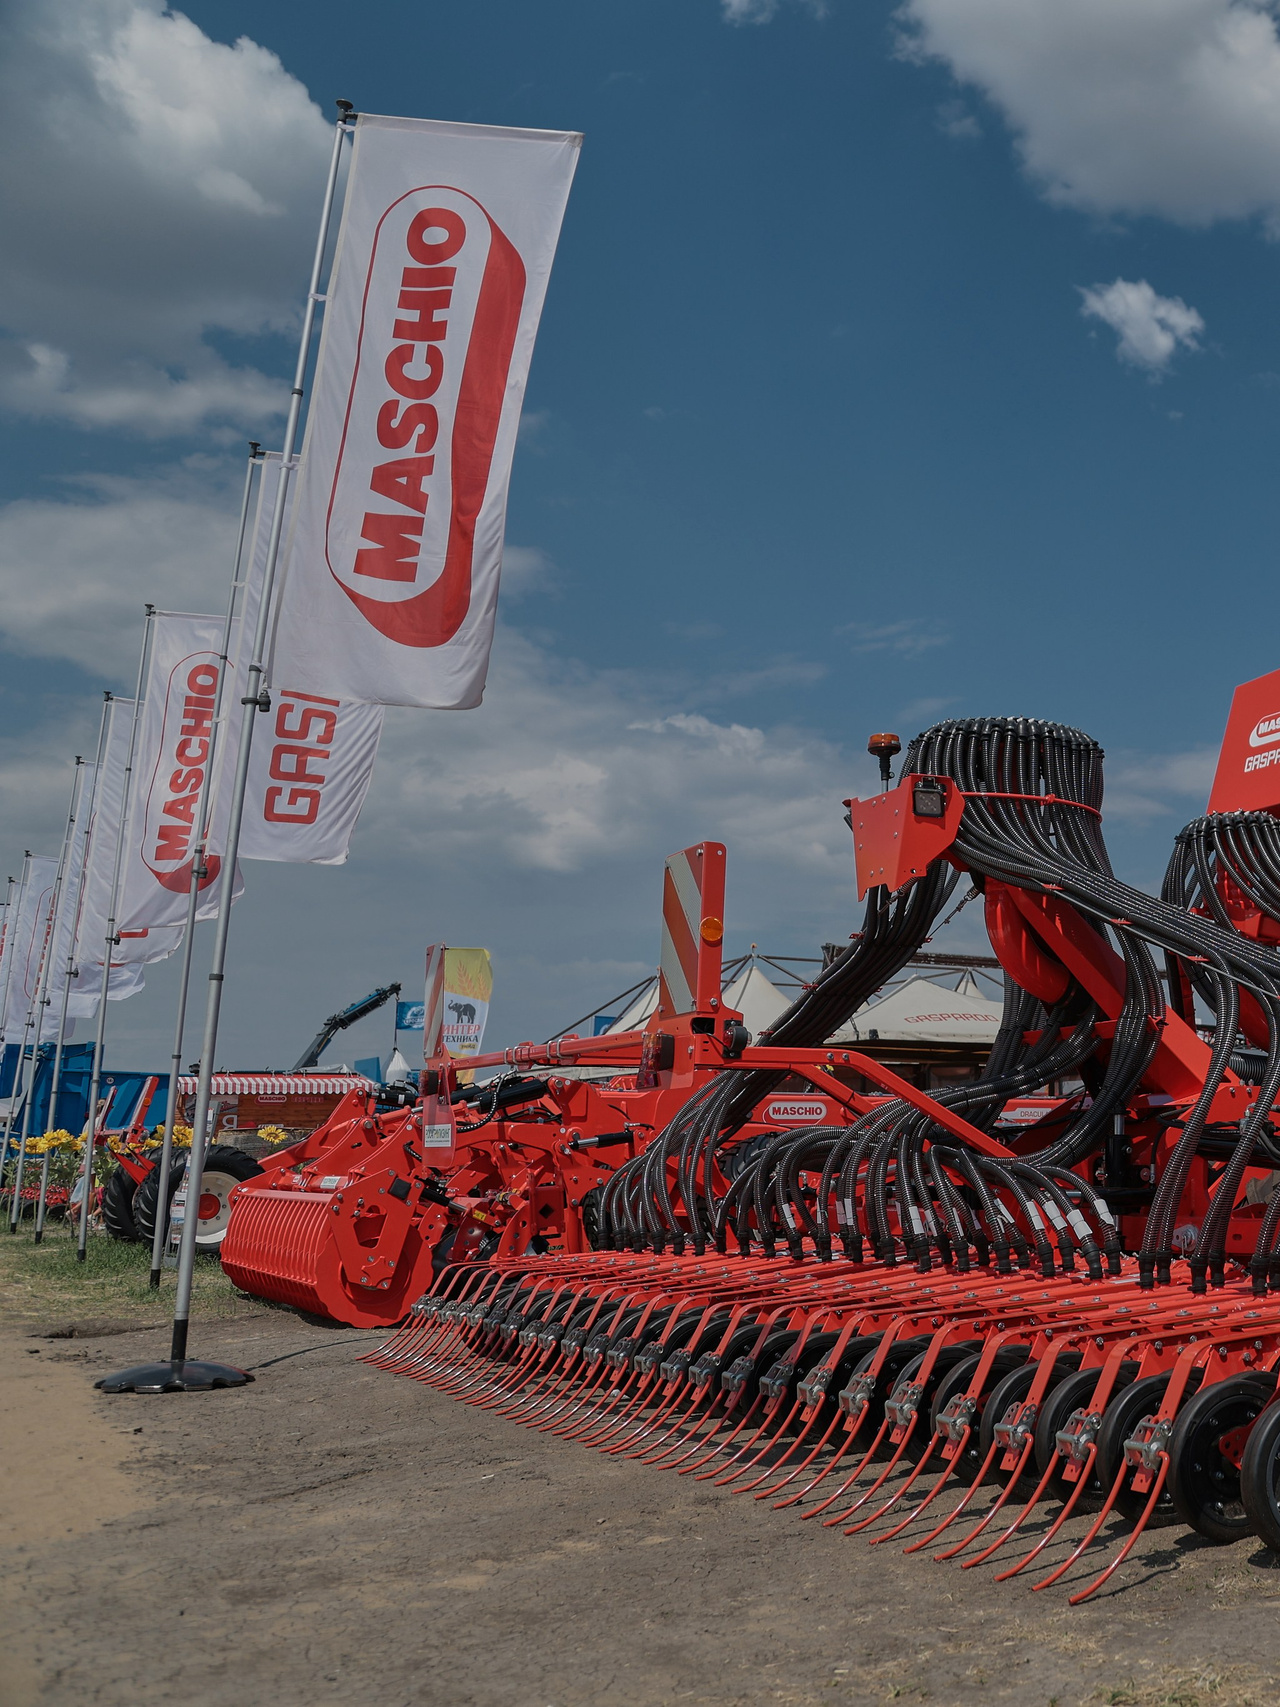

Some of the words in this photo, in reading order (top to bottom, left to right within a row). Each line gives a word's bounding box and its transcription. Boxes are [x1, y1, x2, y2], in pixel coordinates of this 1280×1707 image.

[352, 207, 467, 583] MASCHIO
[154, 663, 220, 861] MASCHIO
[263, 689, 340, 825] GAS
[904, 1013, 1000, 1024] GASPARDO
[442, 1024, 481, 1035] ИНТЕР
[442, 1035, 479, 1043] ТЕХНИКА
[772, 1106, 823, 1116] MASCHIO
[1020, 1110, 1049, 1118] DRACUL
